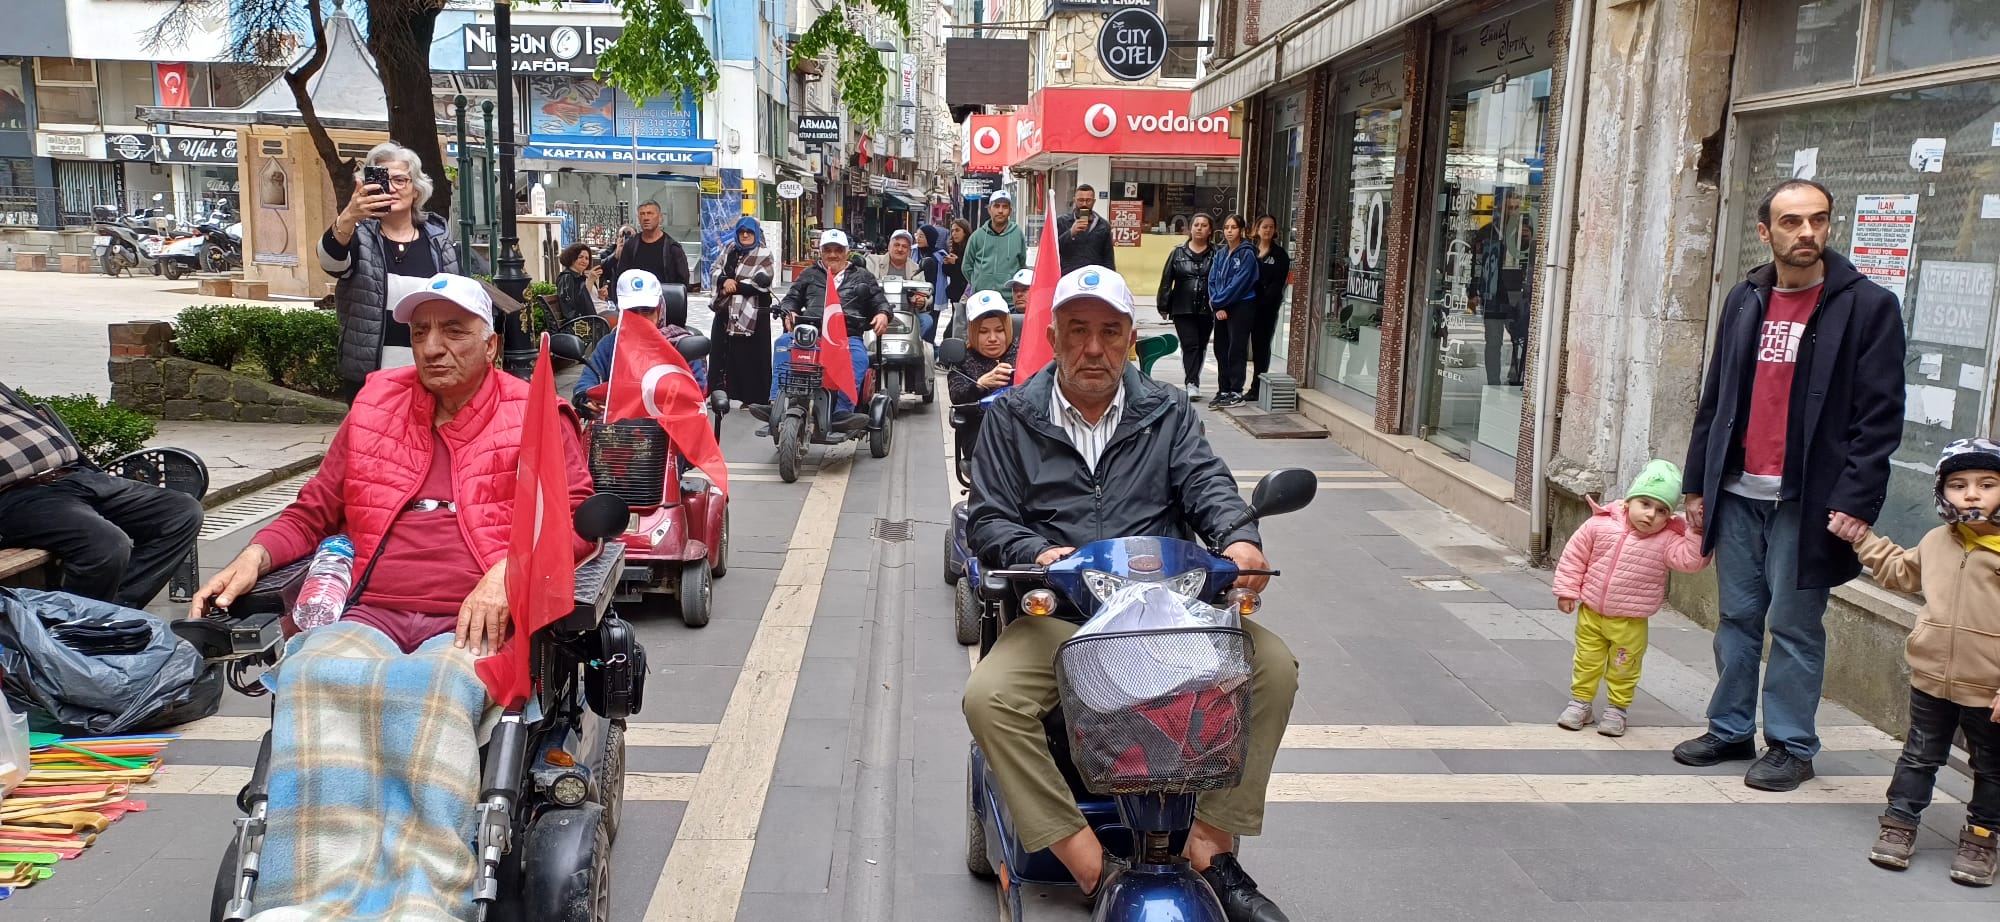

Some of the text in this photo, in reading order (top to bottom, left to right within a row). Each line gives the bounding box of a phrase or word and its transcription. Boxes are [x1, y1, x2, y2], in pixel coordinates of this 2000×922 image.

[1117, 29, 1151, 44] CITY
[1110, 46, 1156, 64] OTEL
[623, 119, 645, 127] 056
[799, 119, 838, 129] ARMADA
[1127, 110, 1228, 133] vodafon
[178, 139, 218, 160] Ufuk
[543, 148, 693, 163] KAPTAN BALIKÇILIK
[1877, 201, 1894, 209] İLAN
